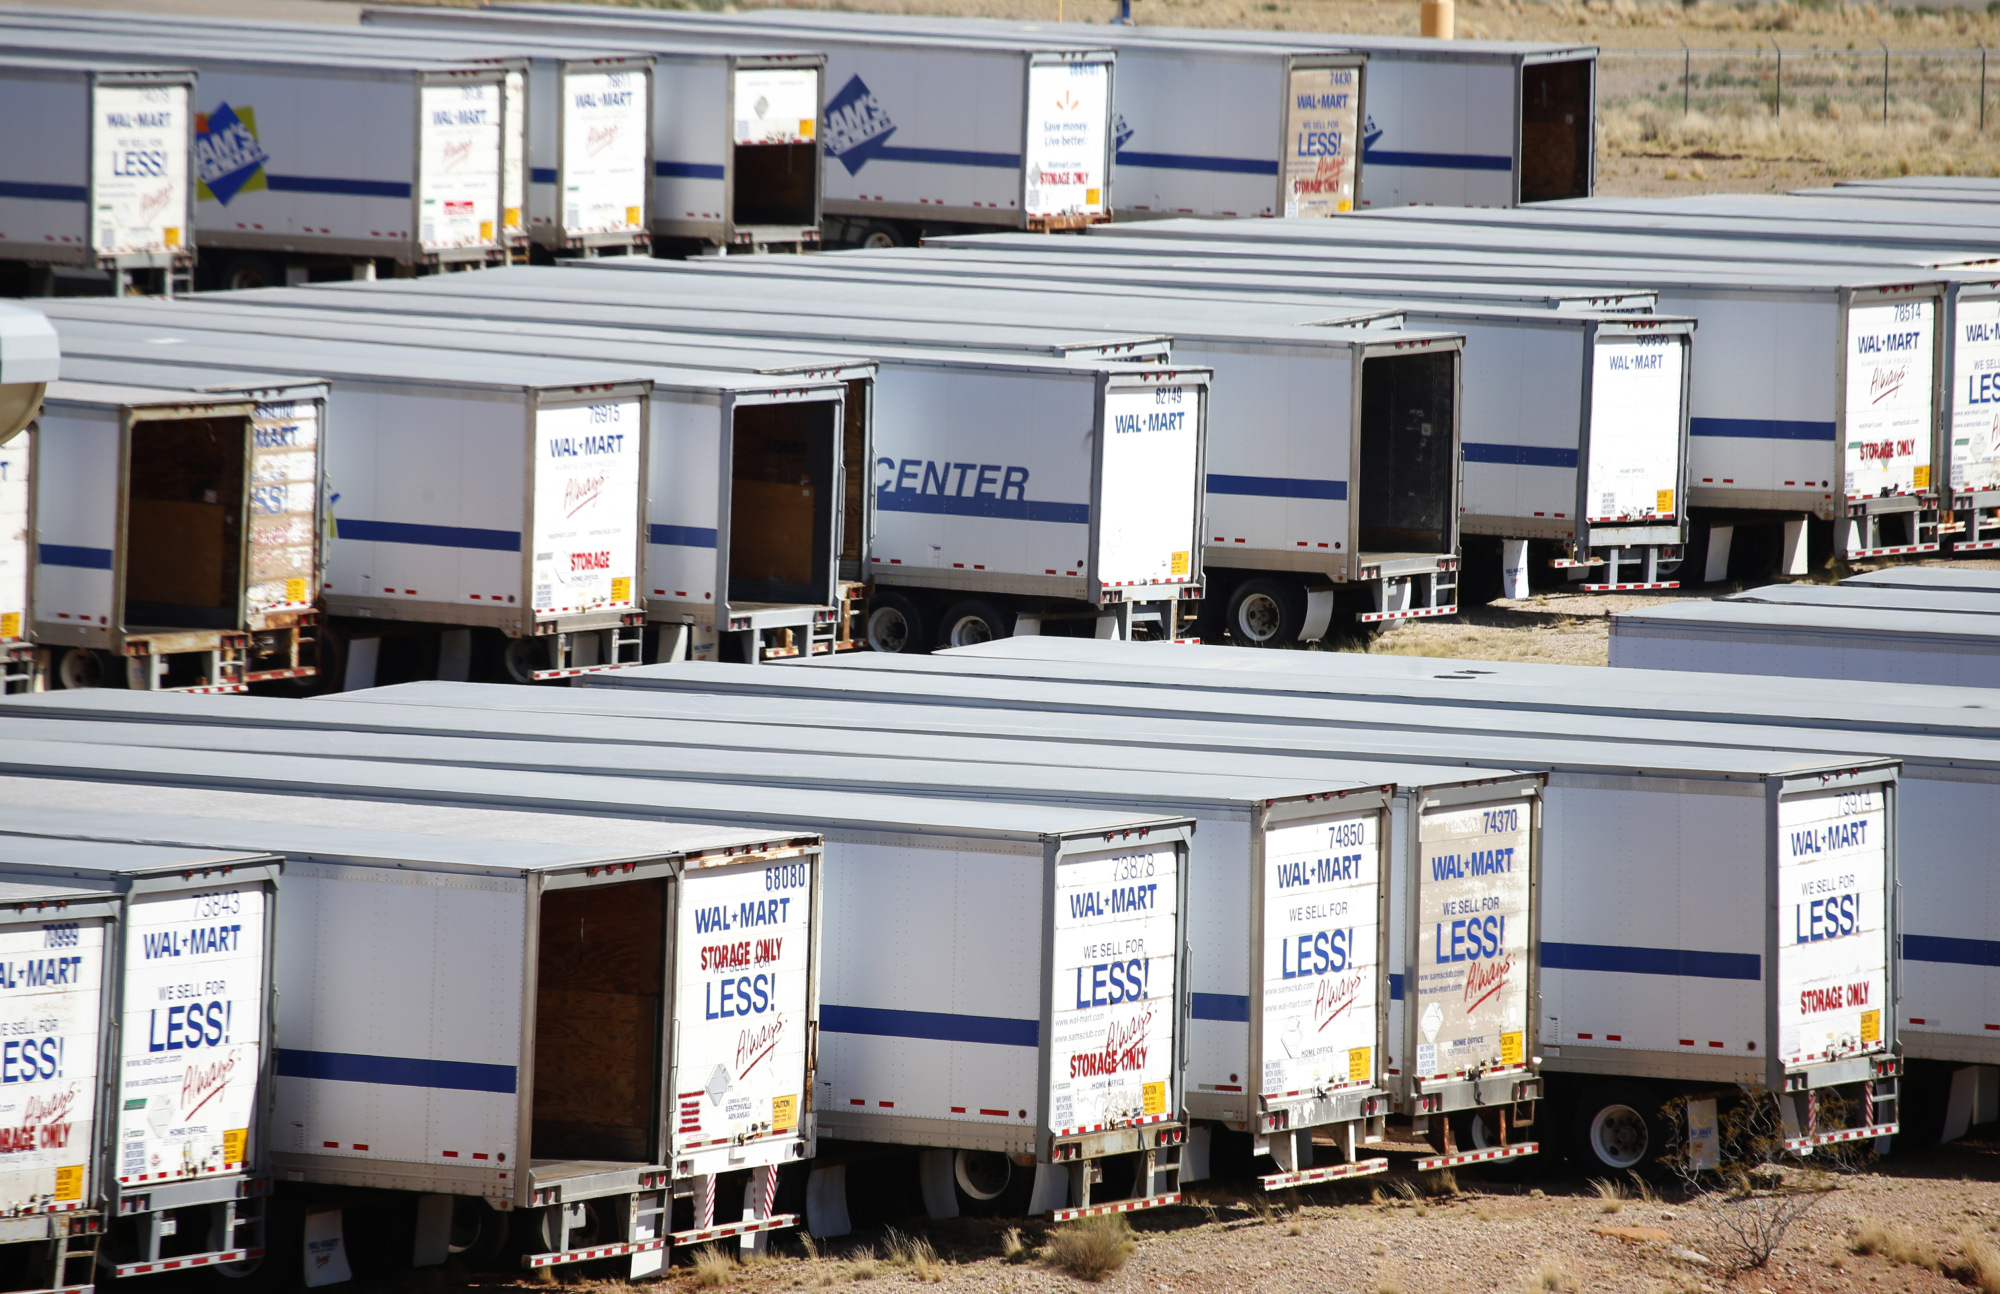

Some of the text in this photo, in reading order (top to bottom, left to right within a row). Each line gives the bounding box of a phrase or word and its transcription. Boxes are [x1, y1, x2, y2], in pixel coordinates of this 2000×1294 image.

[1330, 71, 1351, 86] 74430
[1043, 120, 1061, 132] Save
[1303, 120, 1339, 130] WE SELL FOR
[1045, 135, 1060, 147] Live
[1298, 132, 1342, 157] LESS!
[1040, 171, 1089, 185] STORAGE ONLY
[1294, 179, 1340, 194] STORAGE ONLY
[1895, 303, 1921, 322] 78514
[1156, 387, 1182, 405] 62149
[588, 404, 620, 424] 76915
[1860, 438, 1915, 461] STORAGE ONLY
[877, 457, 1030, 501] CENTER
[570, 550, 611, 572] STORAGE
[1834, 789, 1872, 816] 73914
[1483, 809, 1517, 834] 74370
[1328, 822, 1364, 849] 74850
[765, 864, 806, 891] 68080
[1112, 853, 1155, 881] 73878
[1801, 874, 1855, 896] WE SELL FOR
[1289, 901, 1348, 922] WE SELL FOR
[1443, 897, 1500, 916] WE SELL FOR
[1797, 892, 1860, 944] LESS!
[1083, 938, 1144, 959] WE SELL FOR
[1436, 915, 1505, 964] LESS!
[701, 937, 783, 971] STORAGE ONLY
[1282, 928, 1353, 980] LESS!
[158, 980, 226, 1001] WE SELL FOR
[1077, 957, 1150, 1009] LESS!
[706, 973, 776, 1020] LESS!
[1801, 980, 1869, 1015] STORAGE ONLY
[11, 1018, 59, 1036] SELL FOR
[149, 1000, 232, 1052] LESS!
[1301, 1046, 1333, 1057] HOME OFFICE
[1453, 1036, 1484, 1047] HOME OFFICE
[0, 1037, 64, 1084] ESS!
[1070, 1046, 1149, 1079] STORAGE ONLY
[1092, 1081, 1106, 1089] HOME
[726, 1103, 752, 1113] BENTONVILLE
[773, 1100, 790, 1108] CAUTION
[728, 1112, 750, 1120] ARKANSAS
[40, 1123, 72, 1149] ONLY
